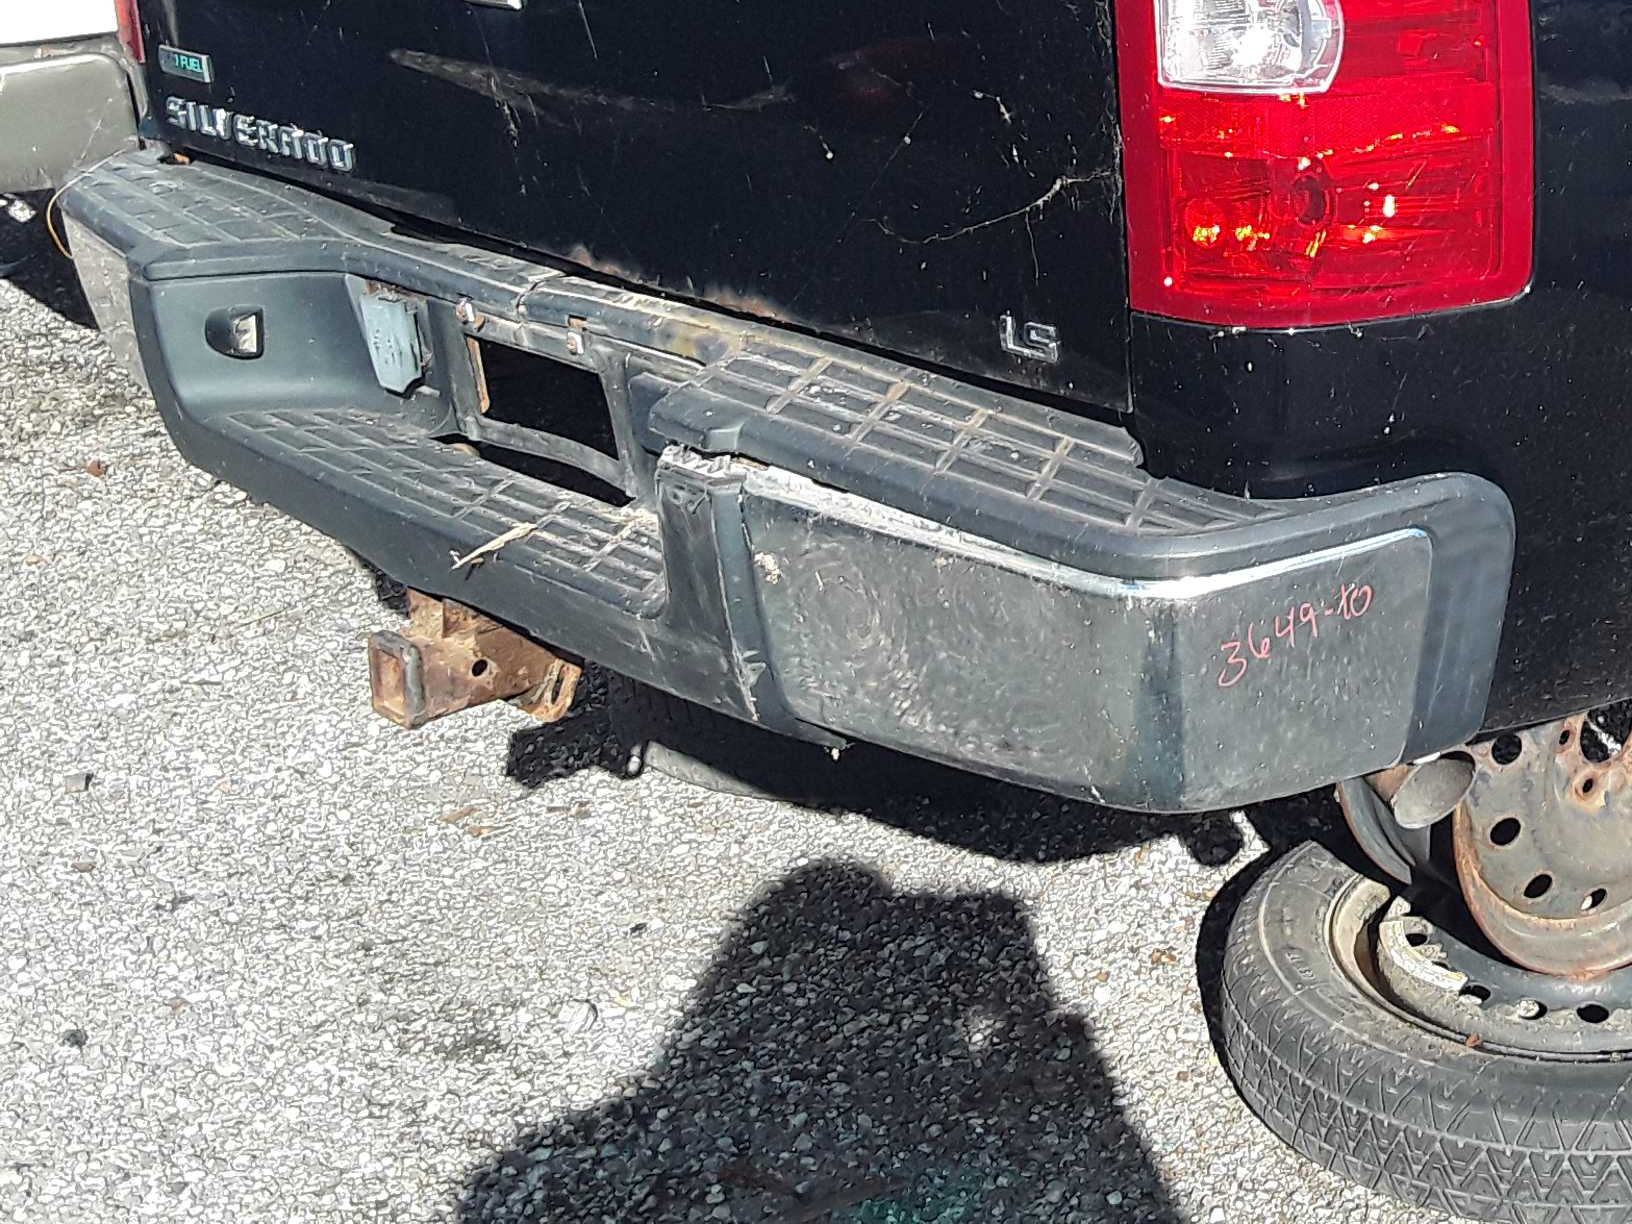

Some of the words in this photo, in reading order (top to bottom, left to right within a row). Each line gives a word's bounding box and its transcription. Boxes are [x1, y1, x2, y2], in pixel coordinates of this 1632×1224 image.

[165, 96, 355, 173] SILVERADO
[999, 313, 1058, 363] LS
[1218, 583, 1375, 687] 3649-10
